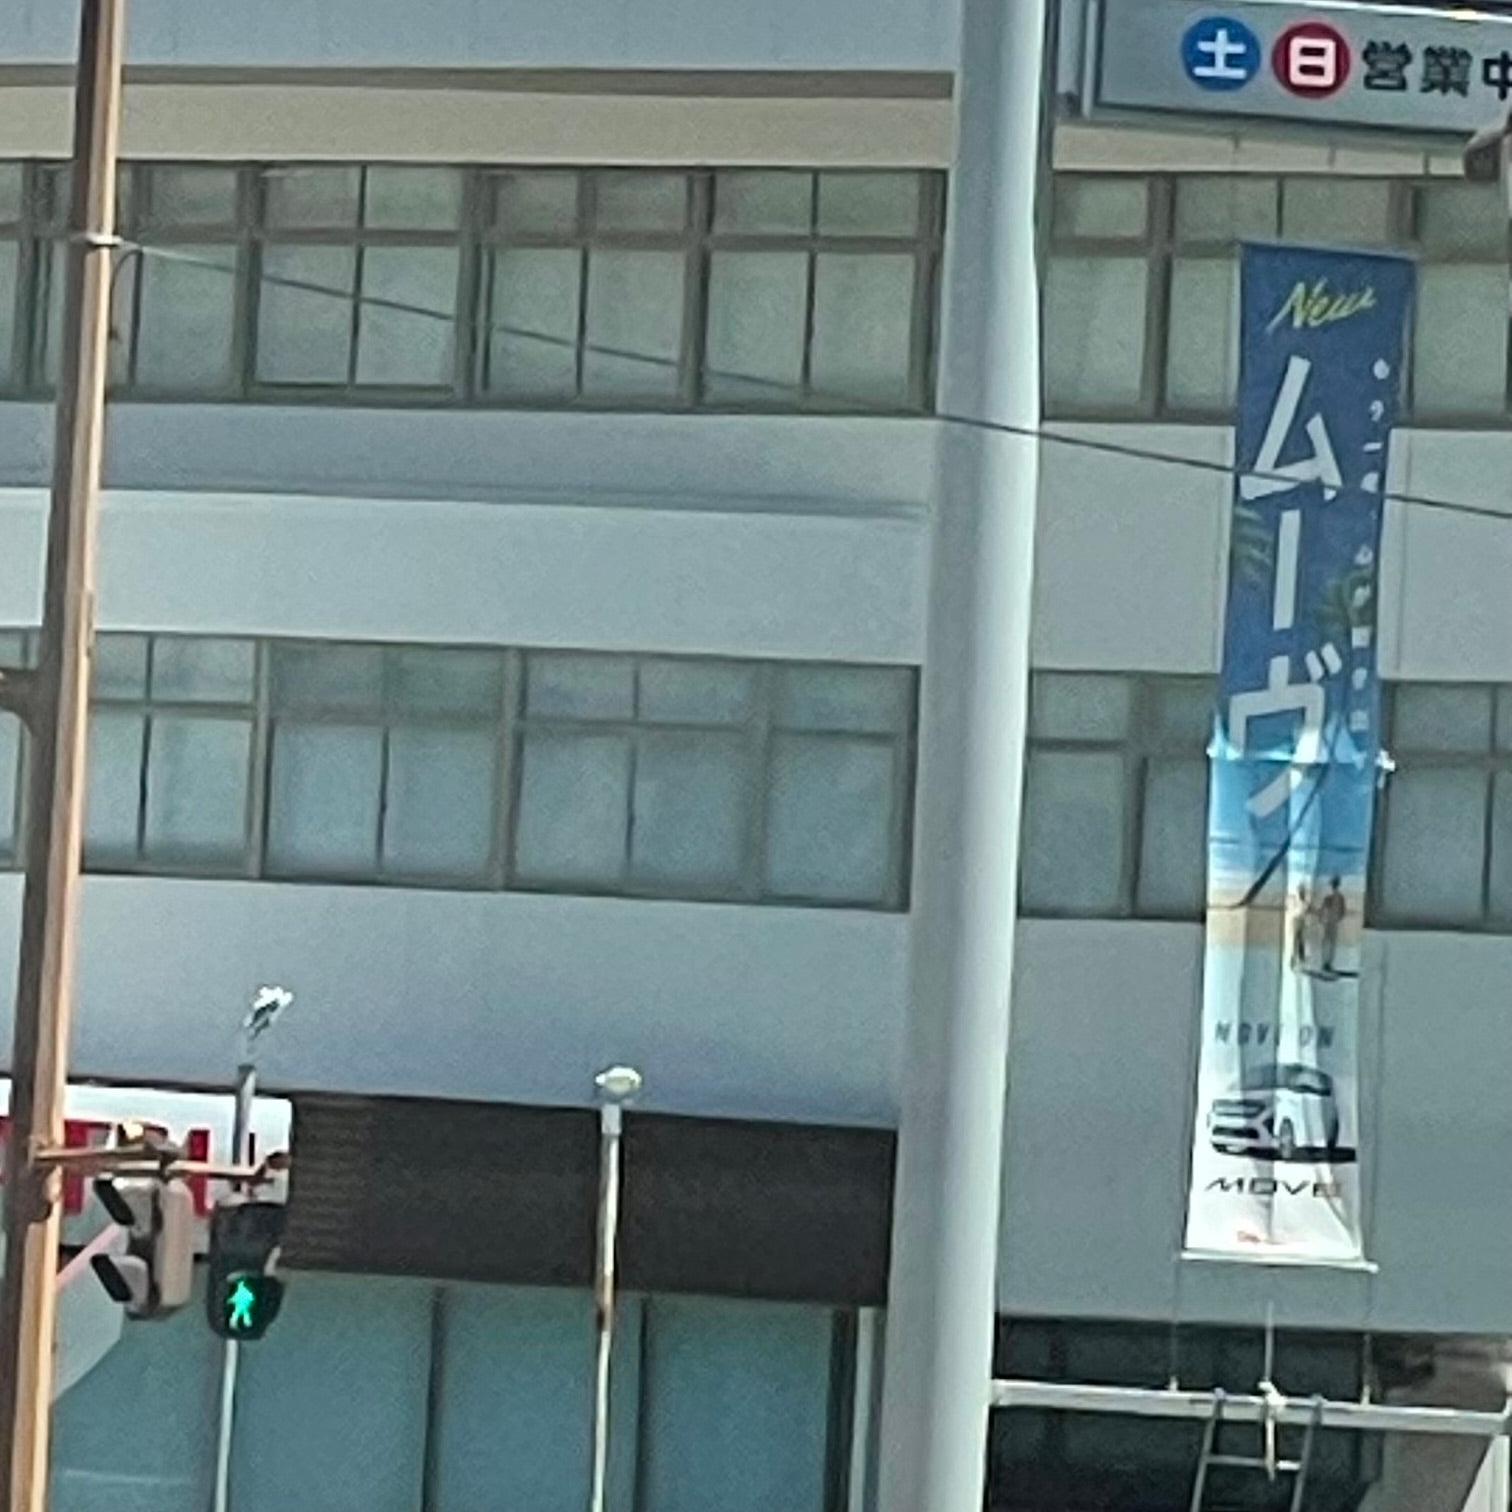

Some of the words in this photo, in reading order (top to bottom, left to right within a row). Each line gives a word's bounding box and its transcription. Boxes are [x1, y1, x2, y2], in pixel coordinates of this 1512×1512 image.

[1190, 26, 1250, 83] 土
[1286, 34, 1340, 90] 日
[1362, 38, 1512, 101] 営業中
[1266, 277, 1377, 334] New
[1228, 354, 1344, 819] ムーヴ
